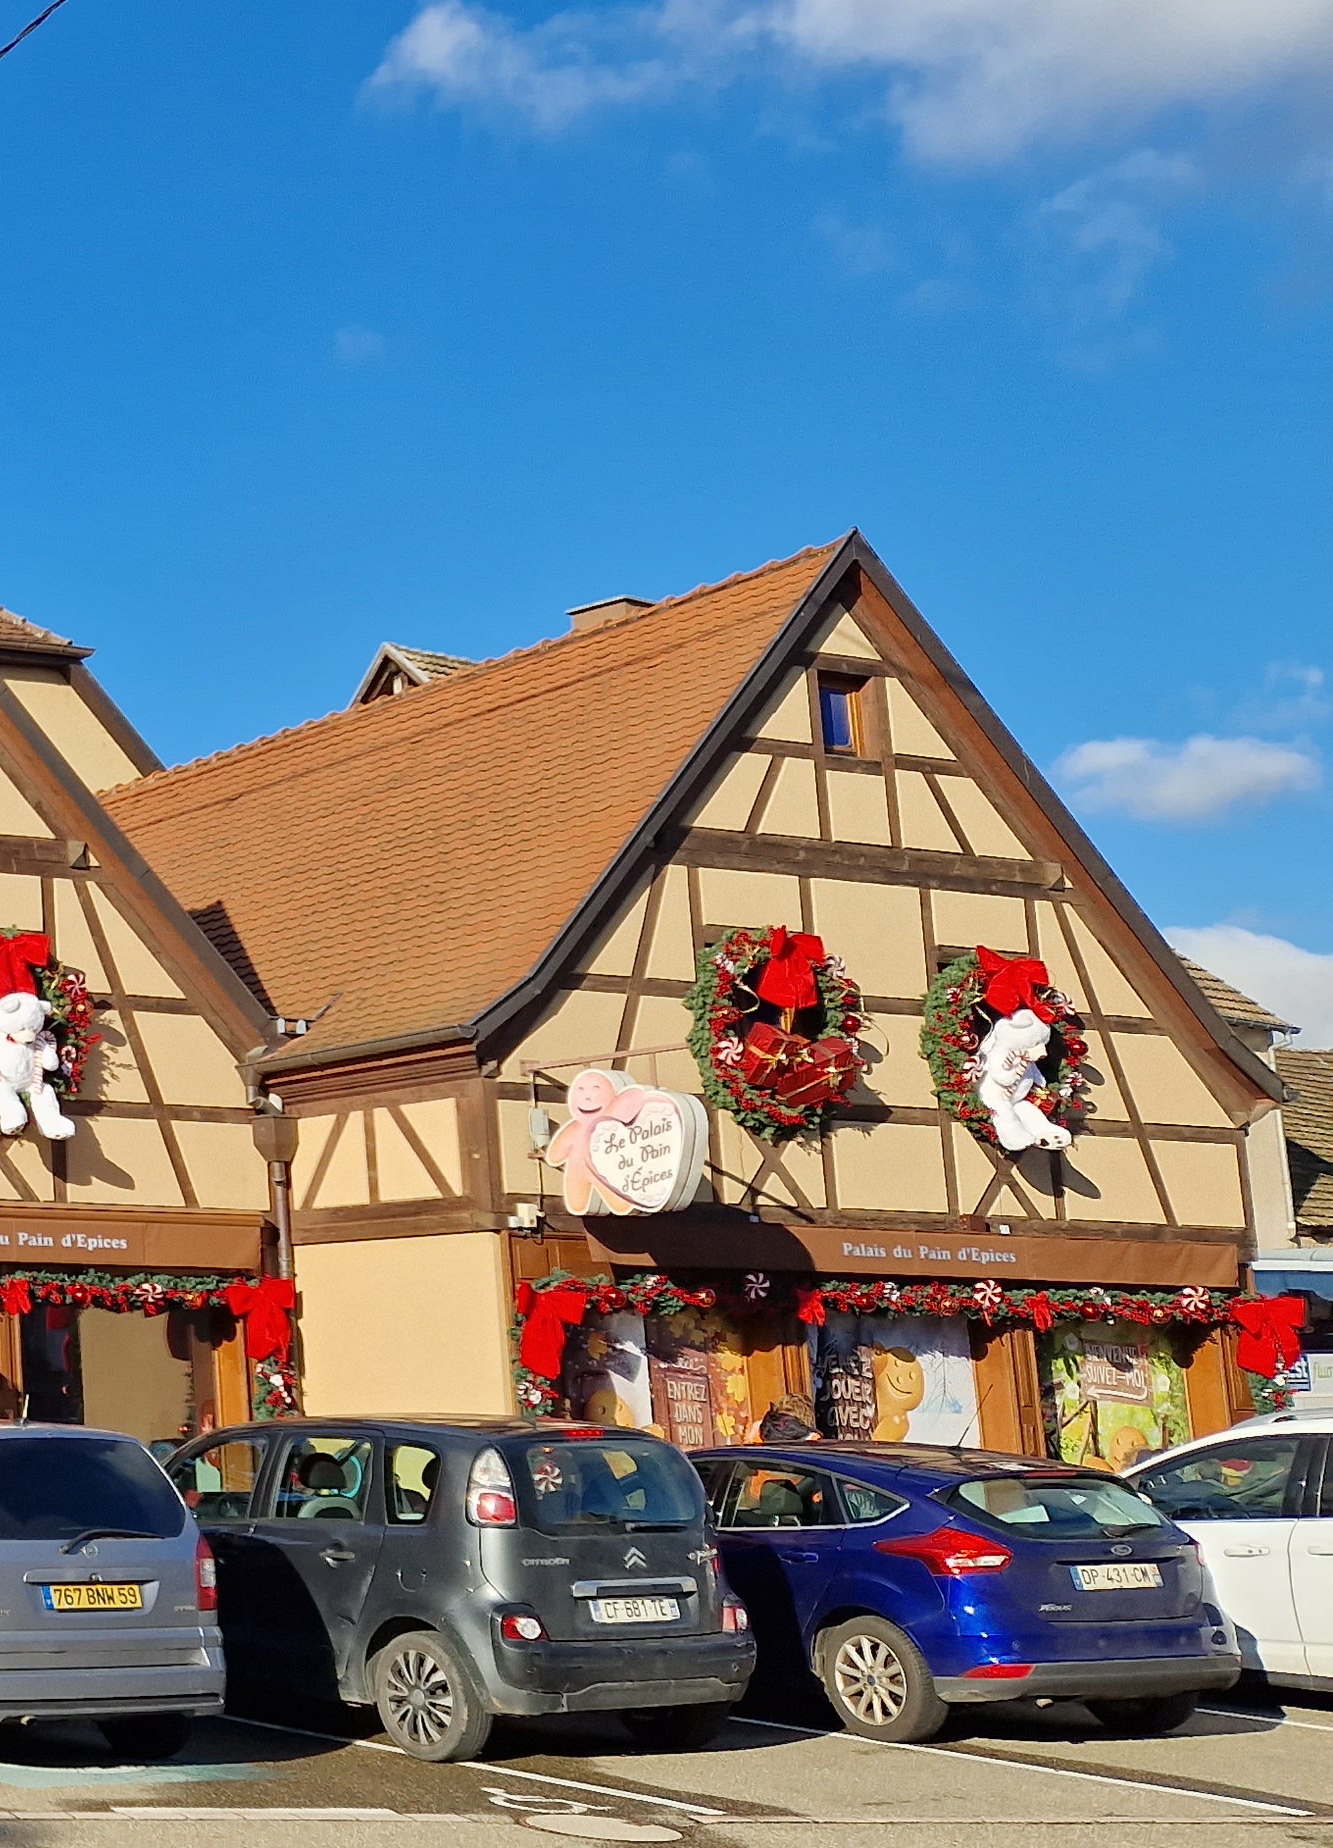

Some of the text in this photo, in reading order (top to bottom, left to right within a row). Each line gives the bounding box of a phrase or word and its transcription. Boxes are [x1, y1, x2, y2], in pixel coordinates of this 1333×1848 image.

[604, 1118, 673, 1155] Le Palais
[618, 1143, 671, 1170] du Pain
[17, 1232, 54, 1247] Pain
[61, 1234, 128, 1251] d'Epices
[842, 1242, 1017, 1264] Palais du Pain d'Epices
[666, 1379, 707, 1402] ENTREZ
[819, 1377, 874, 1404] JOUER
[674, 1402, 703, 1424] DANS
[678, 1425, 704, 1445] MON
[1081, 1567, 1151, 1585] DP-431-CM
[54, 1588, 81, 1606] 767
[86, 1588, 114, 1605] BNW
[119, 1587, 137, 1604] 59
